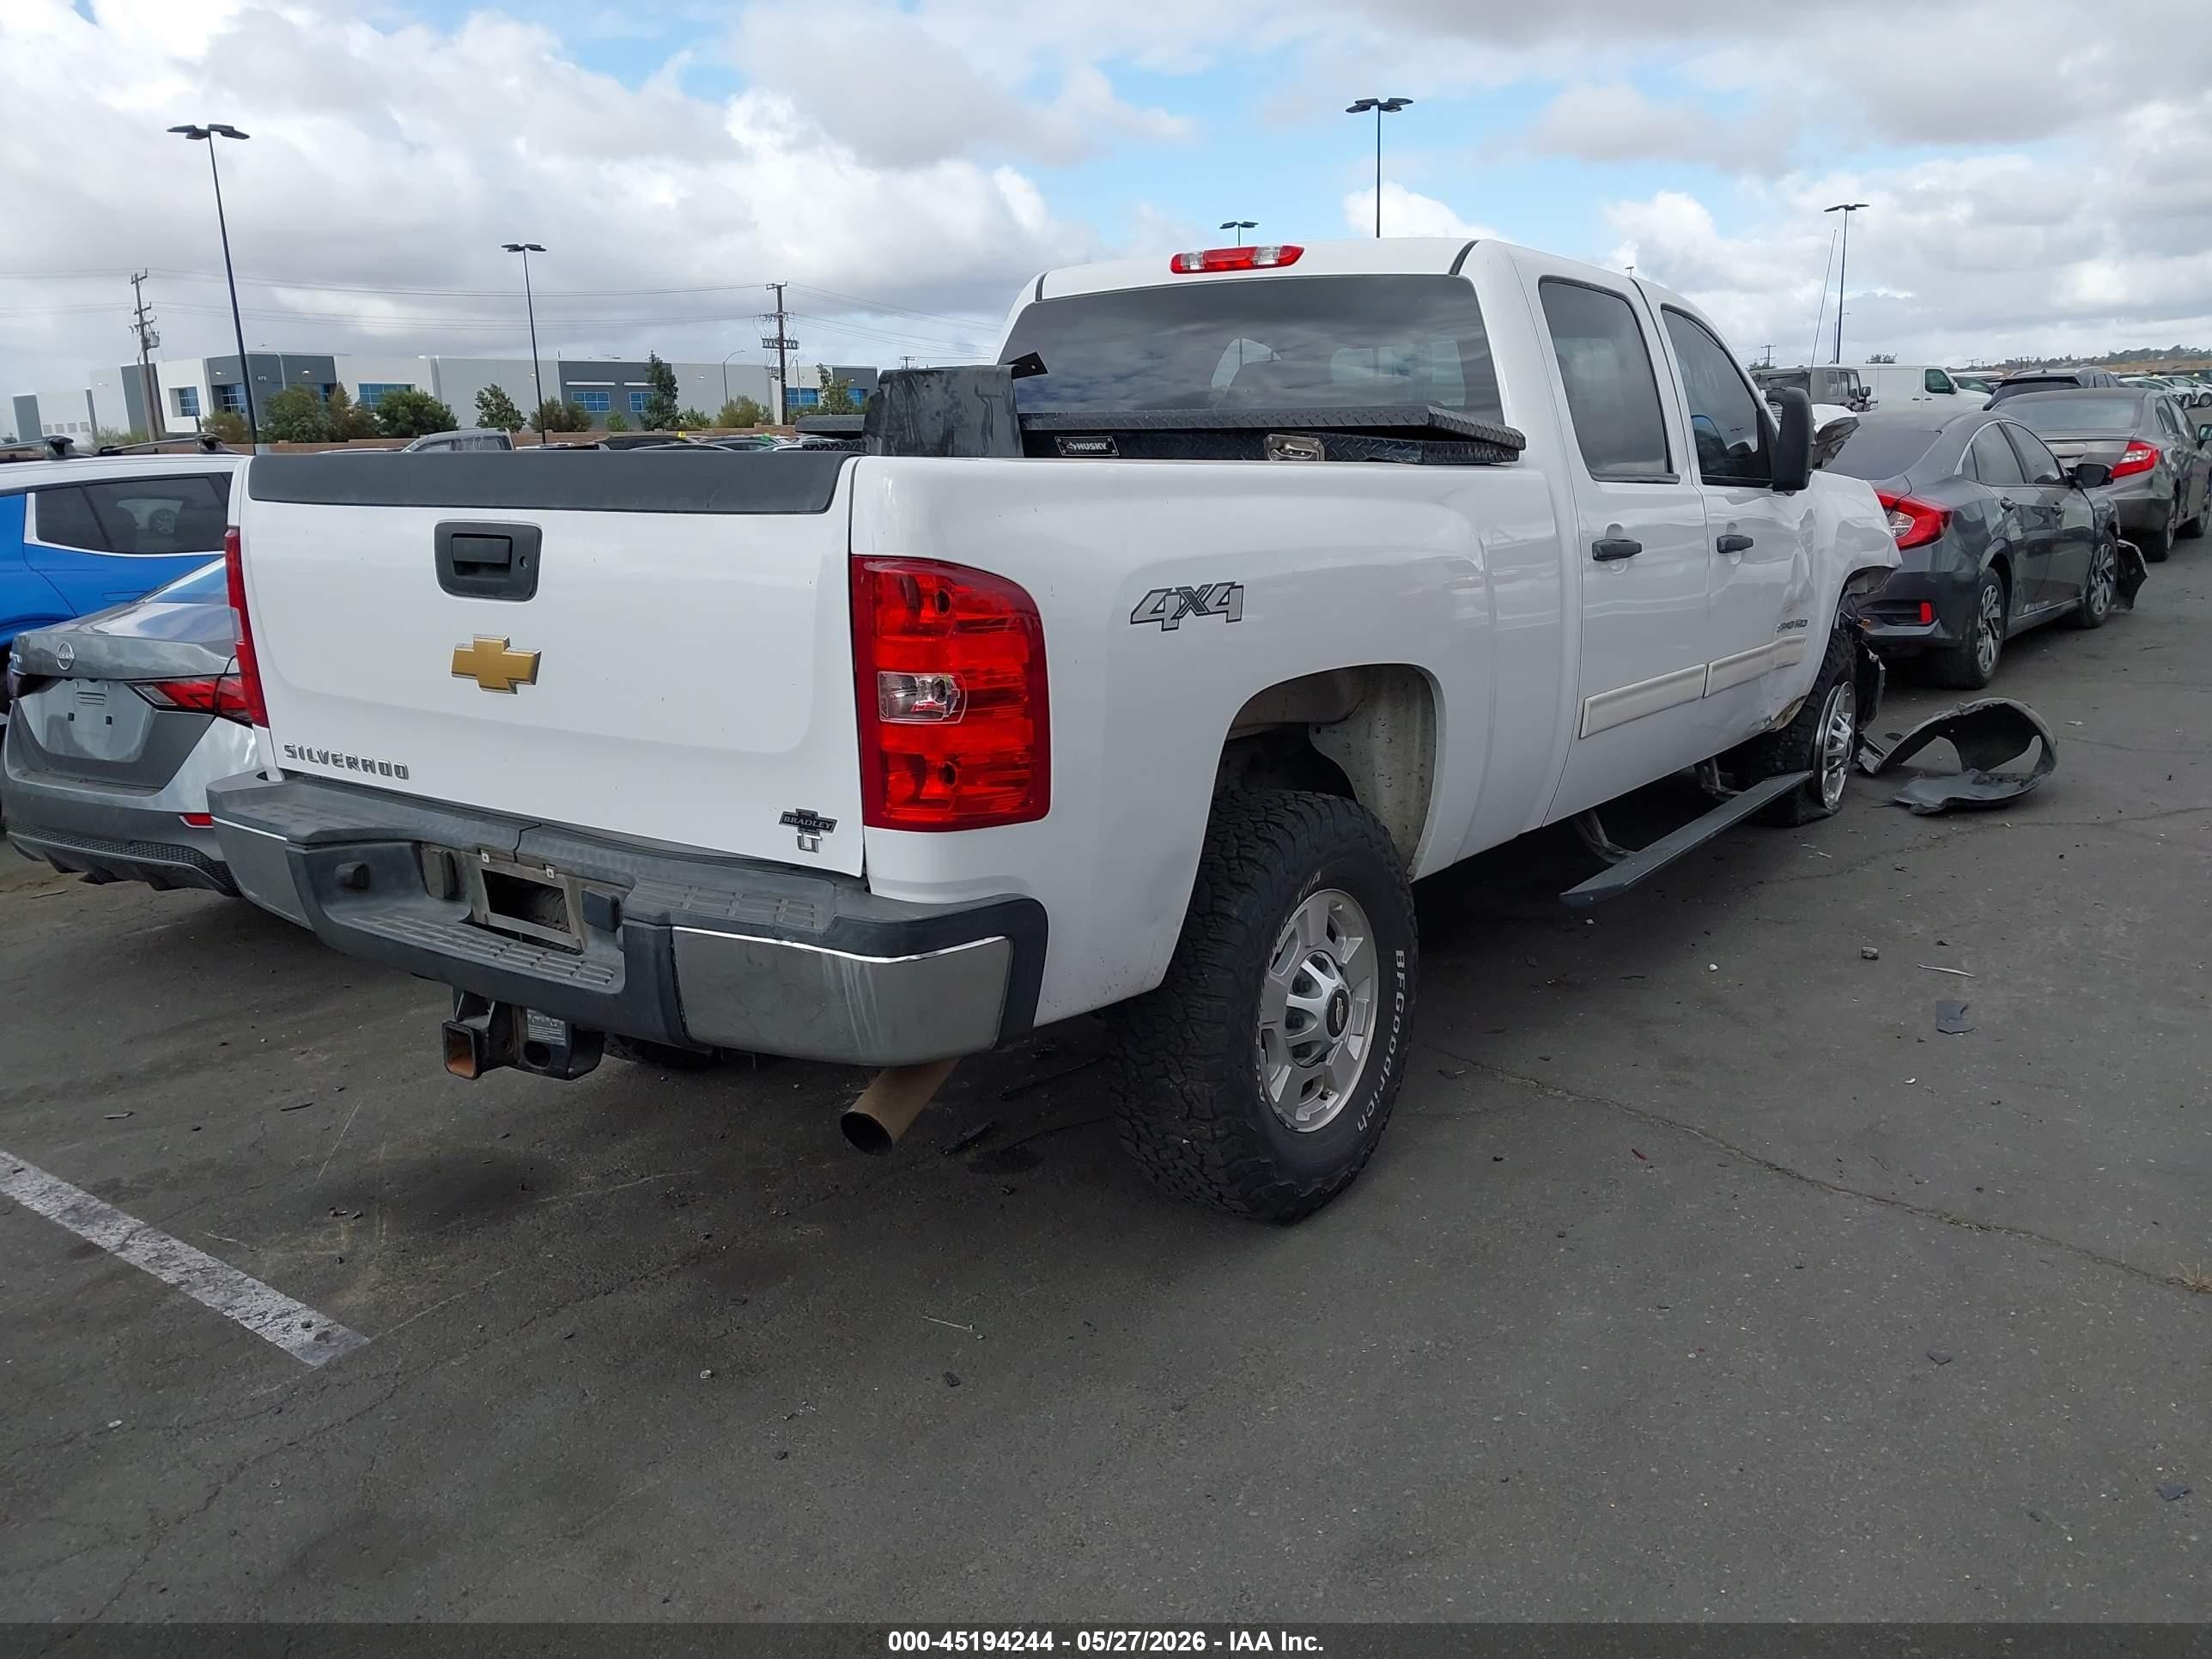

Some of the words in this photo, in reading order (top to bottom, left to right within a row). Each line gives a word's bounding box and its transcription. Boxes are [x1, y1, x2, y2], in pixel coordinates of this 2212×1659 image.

[1077, 442, 1108, 451] HUSKY
[283, 743, 410, 781] SILVERADO
[782, 816, 833, 830] BRADLEY
[797, 832, 823, 854] LT
[1356, 949, 1407, 1132] BFGoodrich
